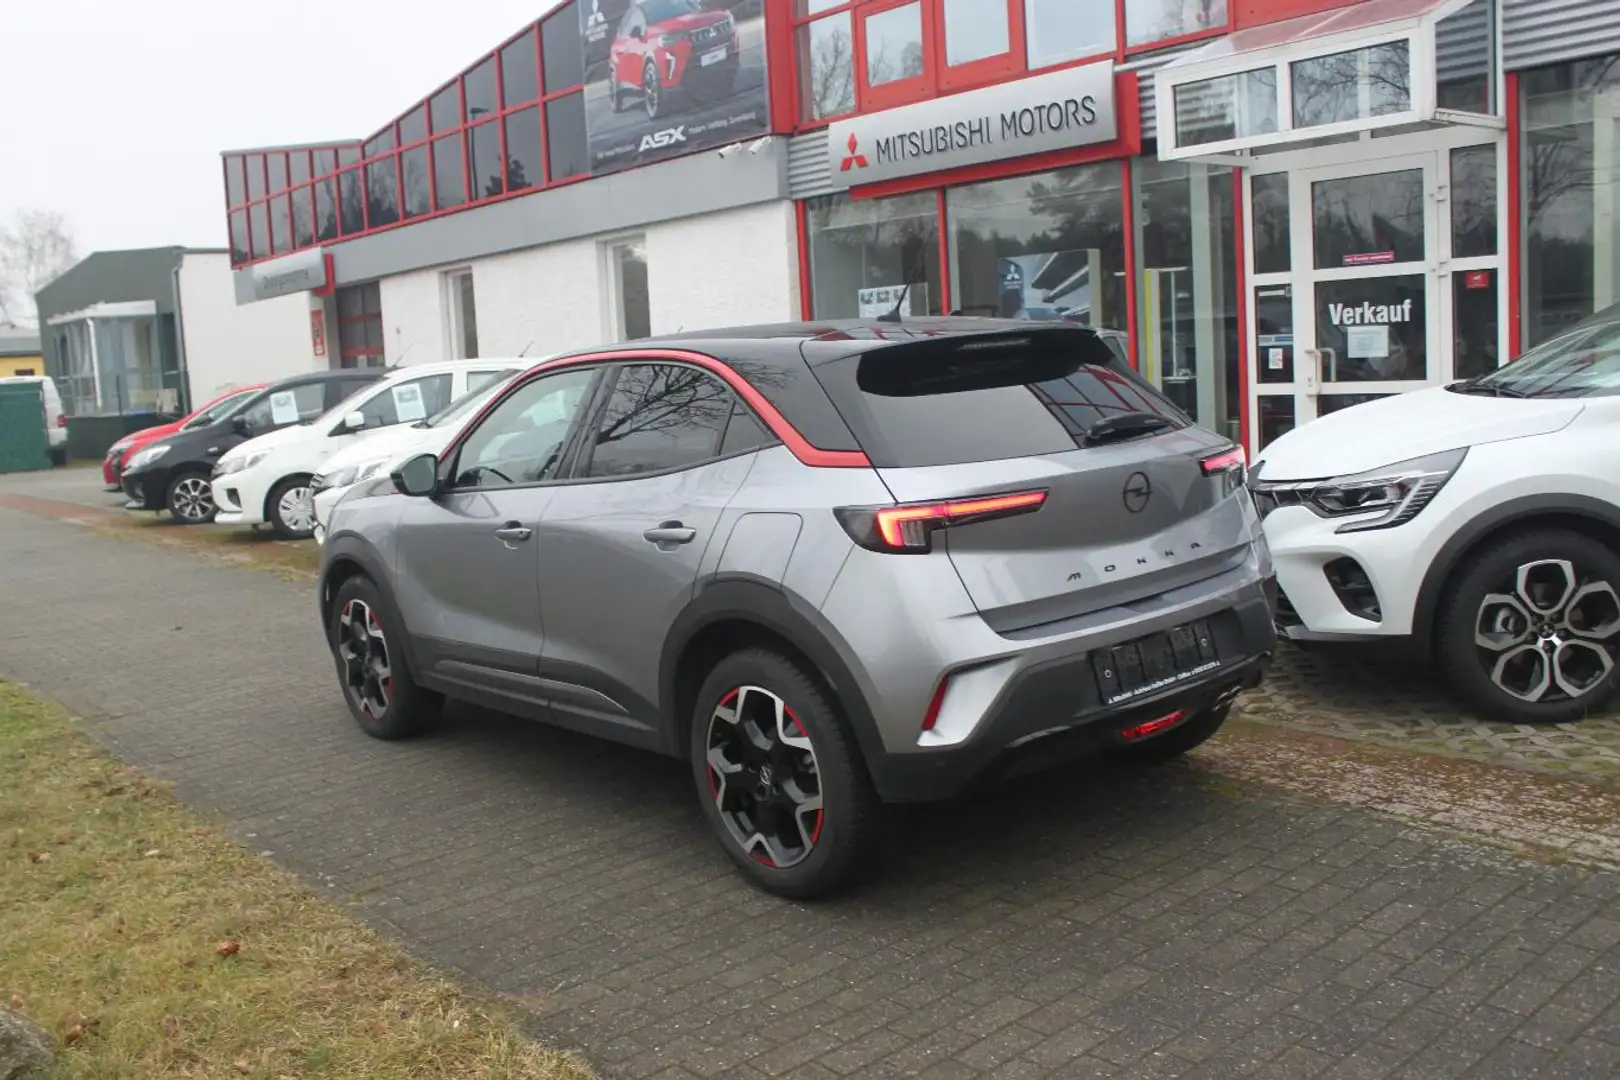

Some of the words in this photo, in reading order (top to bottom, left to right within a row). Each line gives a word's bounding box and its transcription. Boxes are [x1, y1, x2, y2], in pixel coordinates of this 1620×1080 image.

[639, 125, 687, 151] ASX
[876, 116, 992, 163] MITSUBISHI
[1000, 95, 1097, 140] MOTORS
[1329, 299, 1412, 325] Verkauf
[1067, 542, 1202, 581] MOKKA
